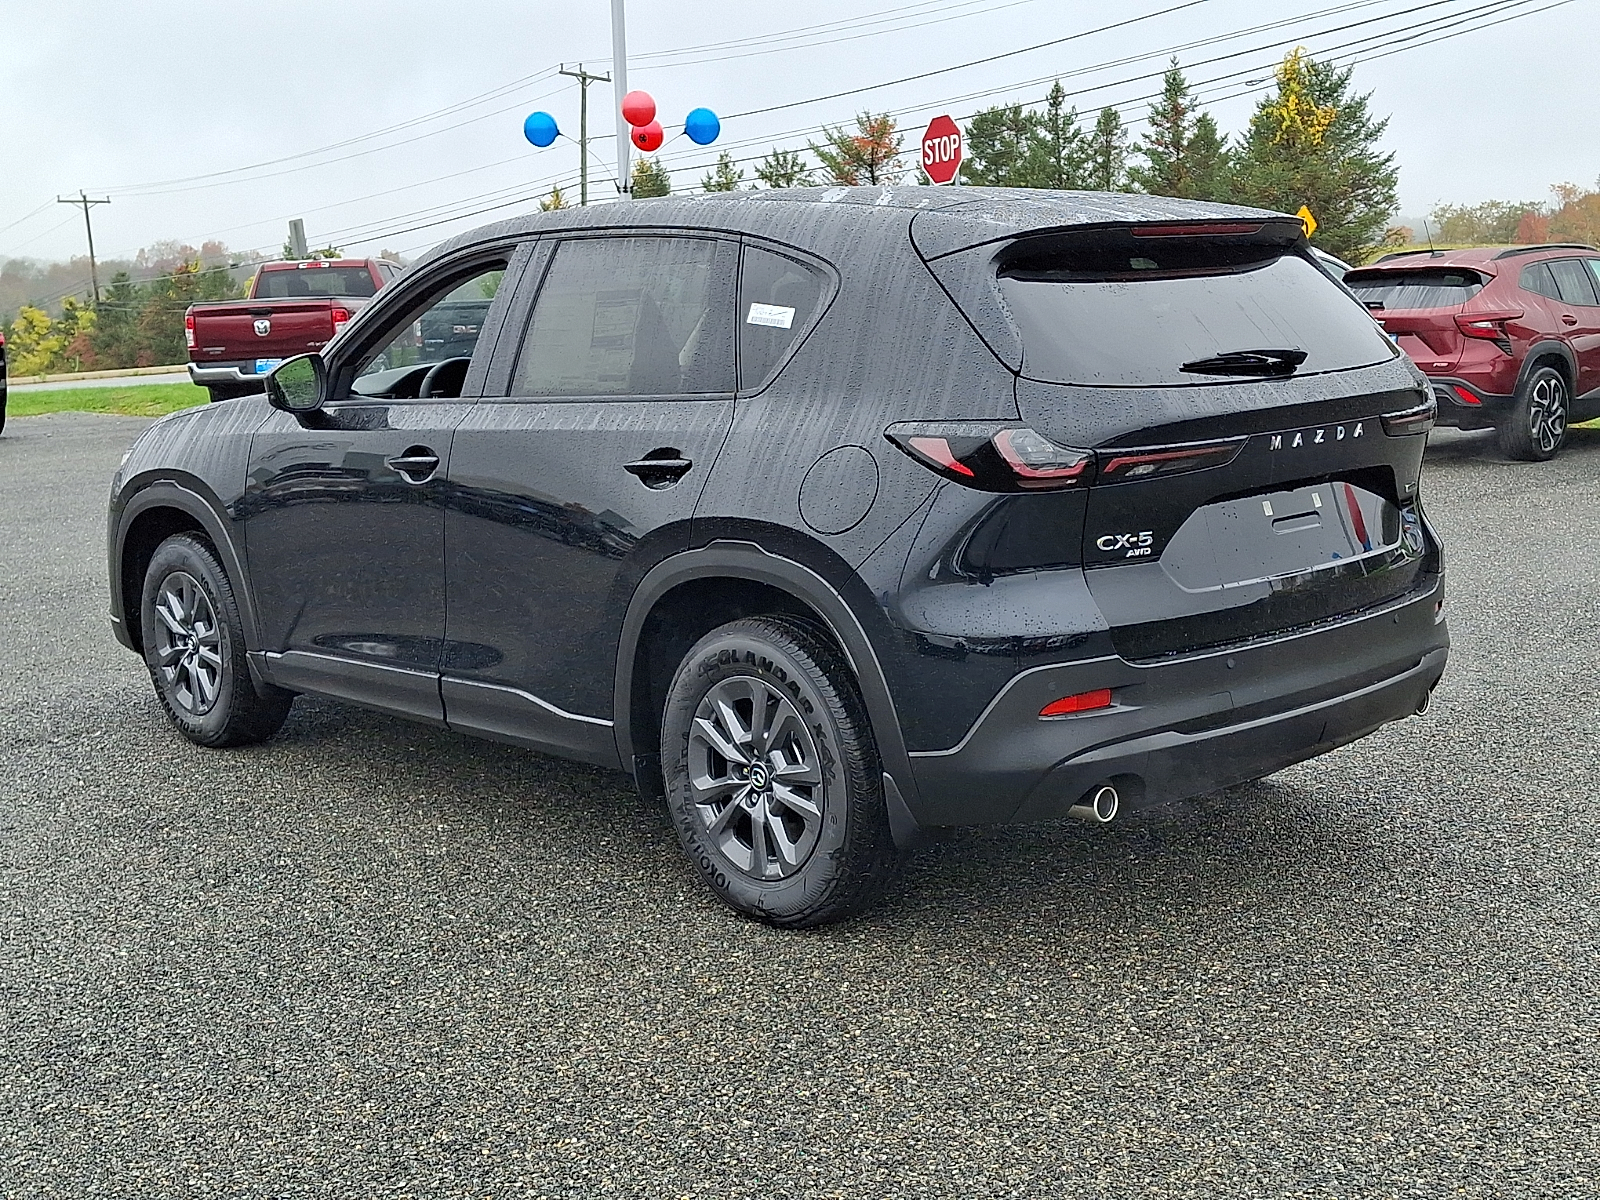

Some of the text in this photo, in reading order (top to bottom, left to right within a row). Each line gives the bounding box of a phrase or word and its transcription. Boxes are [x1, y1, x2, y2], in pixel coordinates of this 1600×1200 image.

[924, 134, 960, 165] STOP
[1269, 422, 1364, 451] MAZDA
[1096, 531, 1153, 551] CX-5
[1125, 547, 1152, 557] AWD
[676, 801, 731, 892] YOKOHAMA
